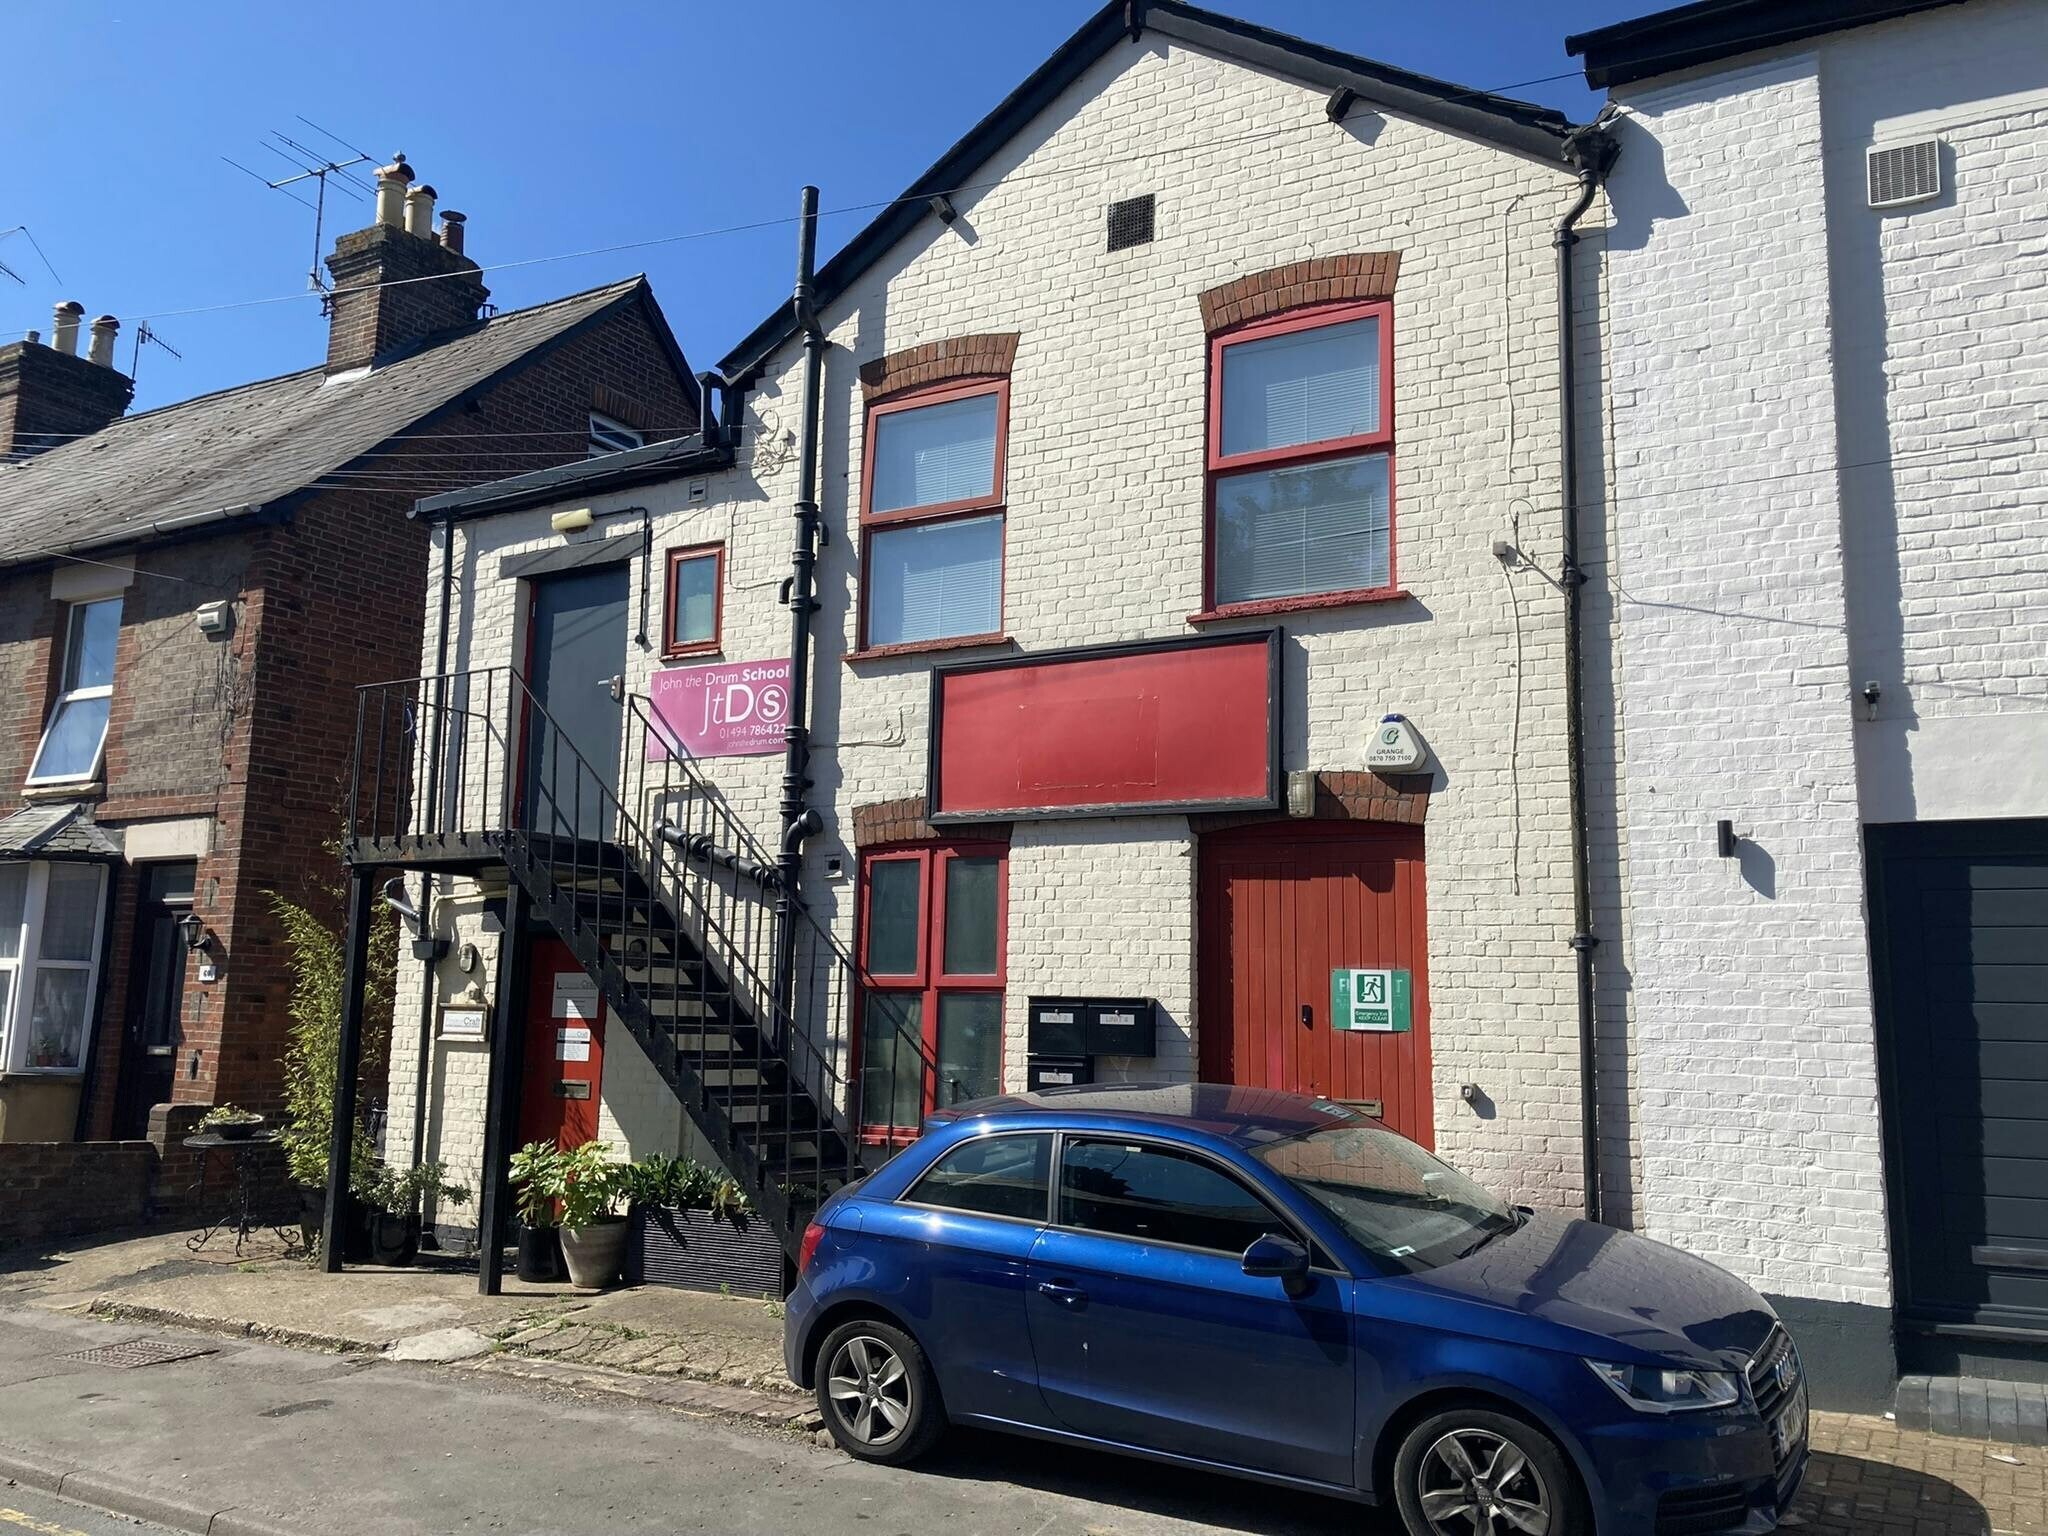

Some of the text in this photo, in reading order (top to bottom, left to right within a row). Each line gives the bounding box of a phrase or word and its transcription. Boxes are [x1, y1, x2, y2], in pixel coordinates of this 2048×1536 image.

[660, 665, 790, 693] John the Drum School
[719, 723, 786, 739] 01494 786422
